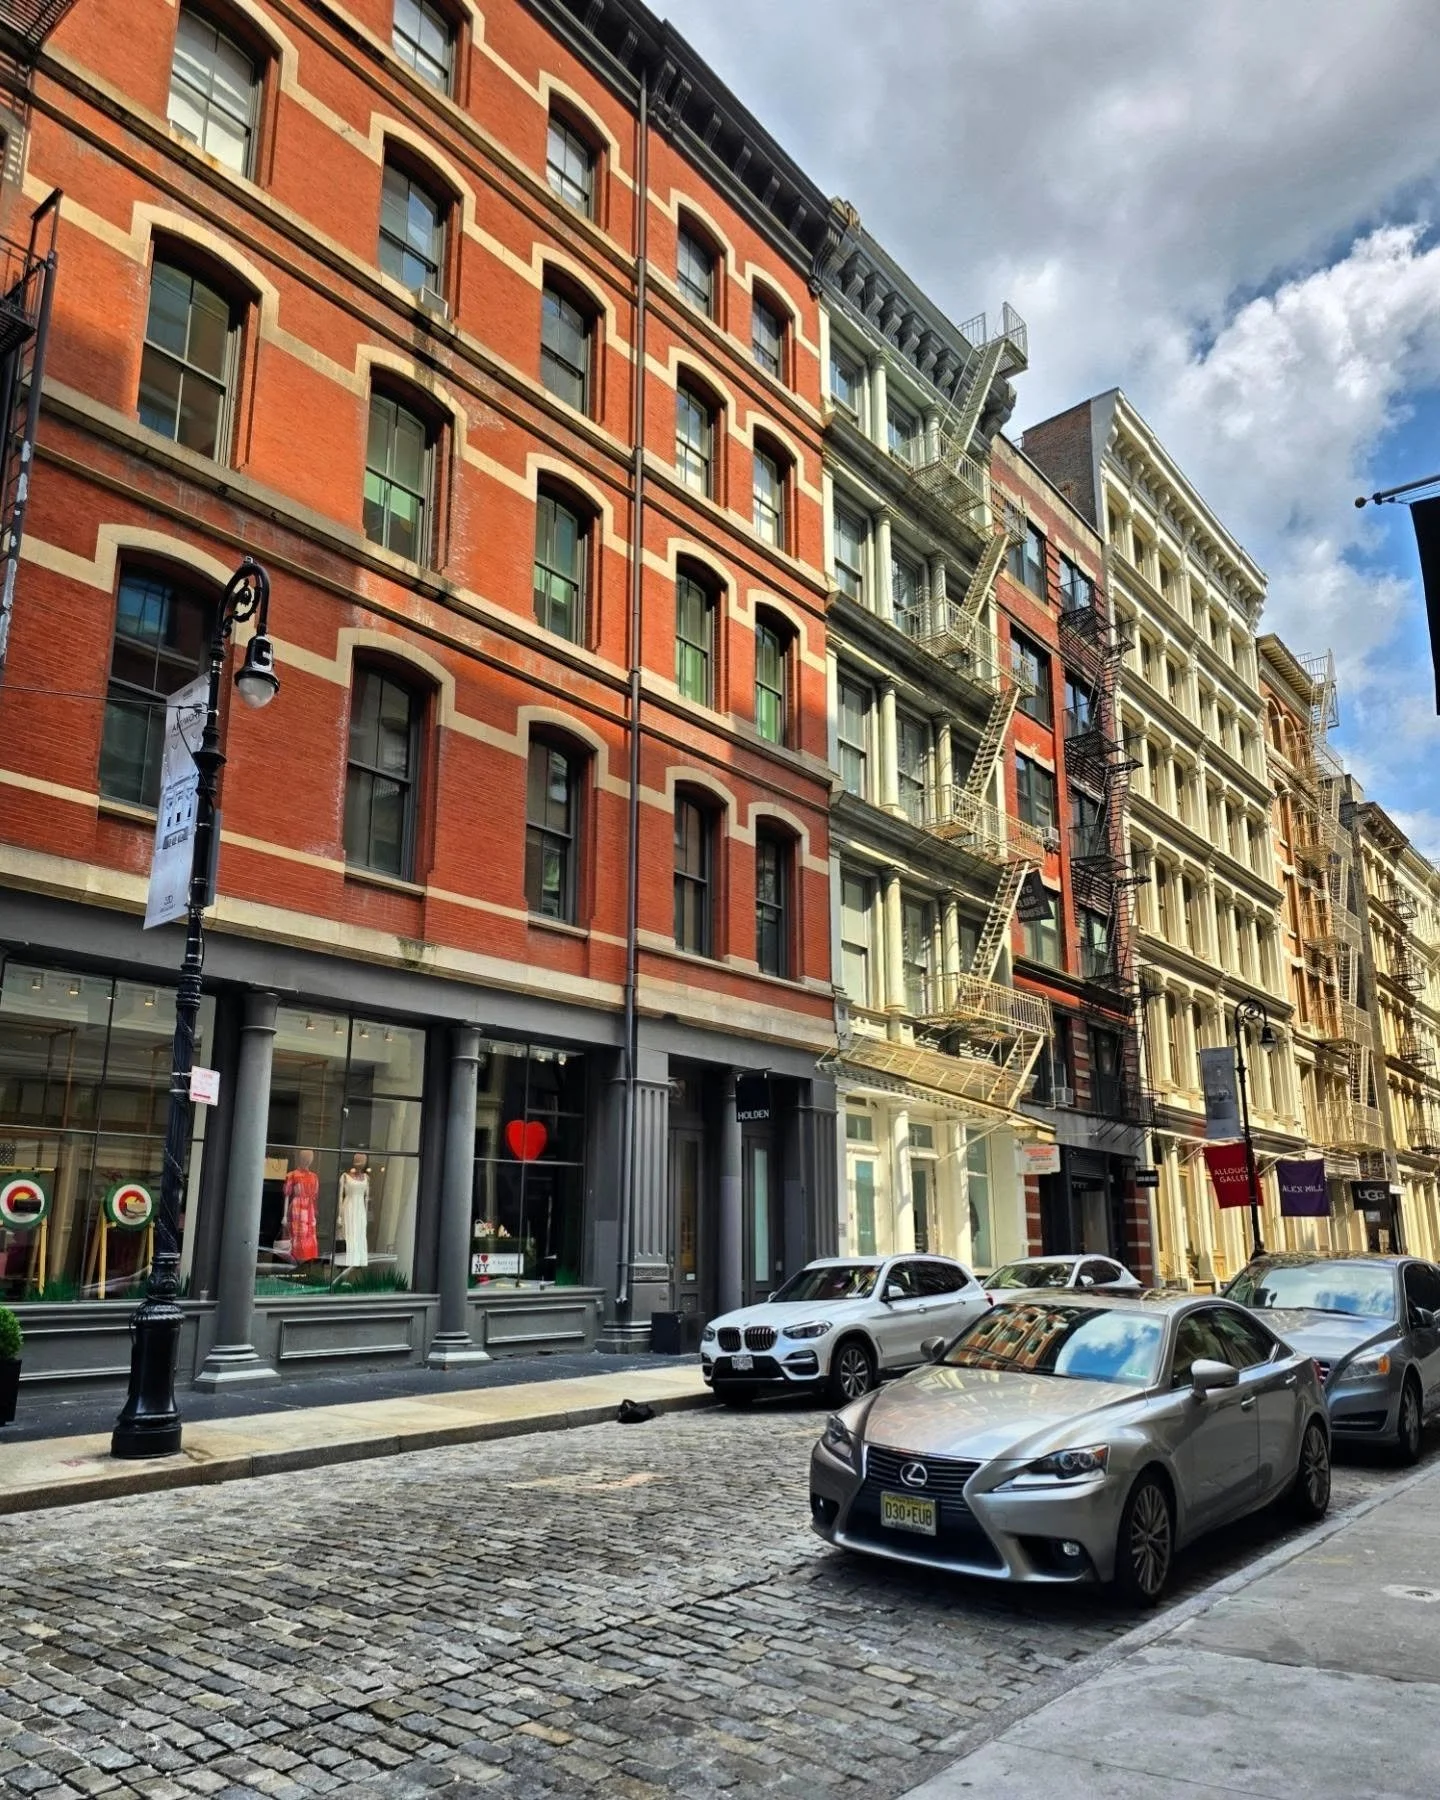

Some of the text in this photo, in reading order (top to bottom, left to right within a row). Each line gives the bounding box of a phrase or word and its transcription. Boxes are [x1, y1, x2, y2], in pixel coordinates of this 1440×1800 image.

[738, 1110, 769, 1120] HOLDEN
[1282, 1184, 1324, 1193] ALEX MILL
[1358, 1189, 1386, 1201] UGG
[475, 1263, 489, 1272] NY
